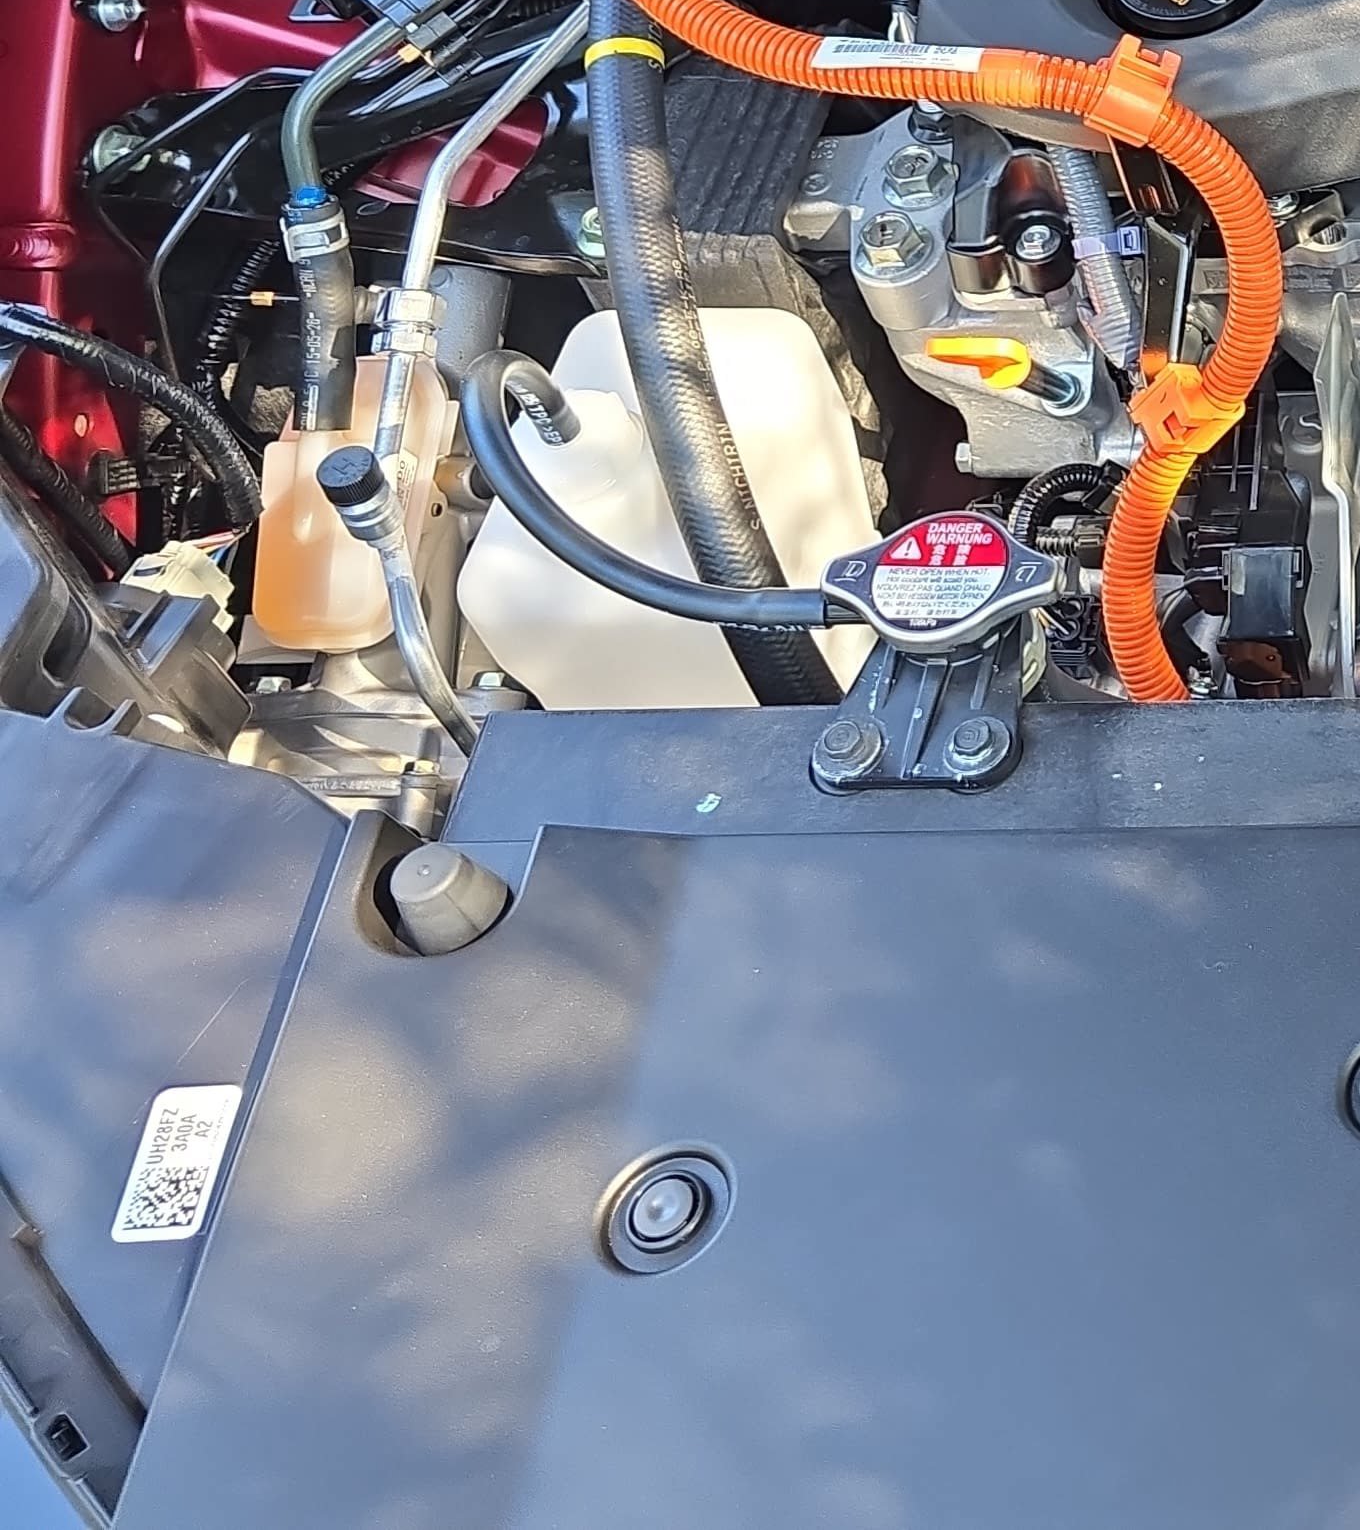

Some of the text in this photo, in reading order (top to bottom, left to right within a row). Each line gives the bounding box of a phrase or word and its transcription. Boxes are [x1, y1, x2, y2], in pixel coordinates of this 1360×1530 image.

[928, 523, 984, 533] DANGER
[926, 533, 993, 545] WARNUNG
[889, 568, 918, 576] NEVER
[920, 568, 944, 576] OPEN
[146, 1107, 179, 1164] UH28FZ
[171, 1114, 197, 1152] 3A0A
[195, 1120, 213, 1138] A2
